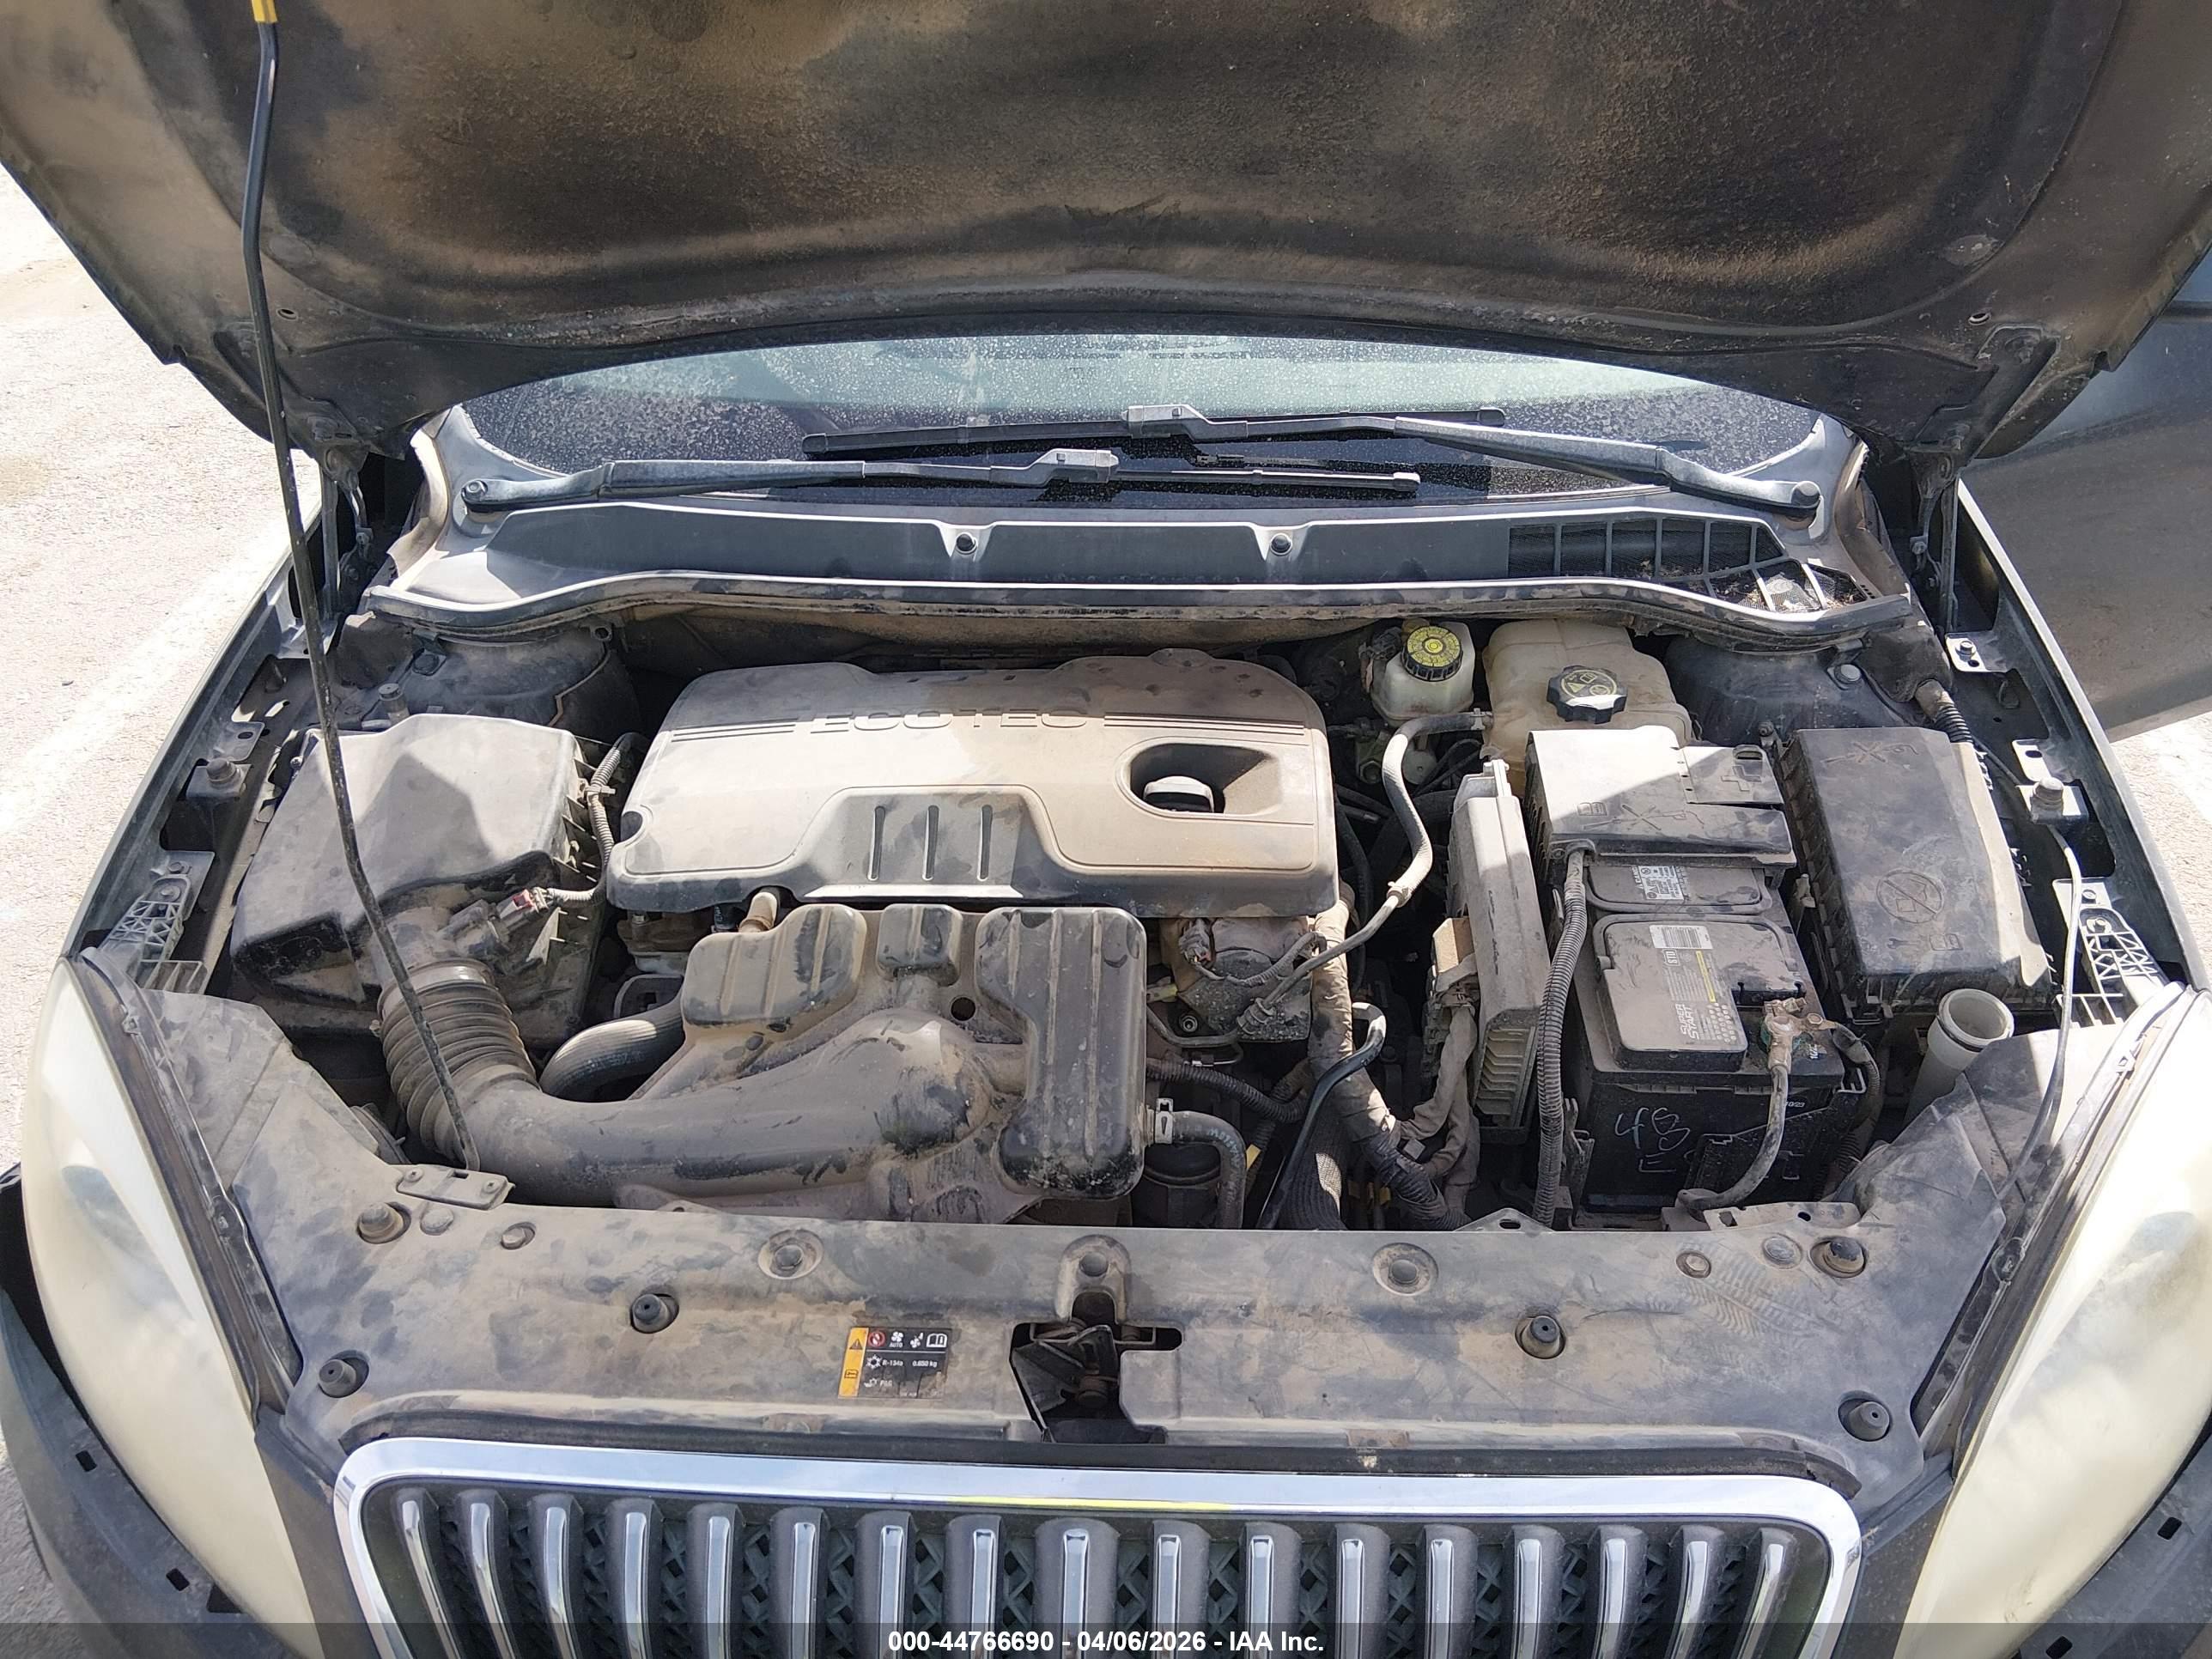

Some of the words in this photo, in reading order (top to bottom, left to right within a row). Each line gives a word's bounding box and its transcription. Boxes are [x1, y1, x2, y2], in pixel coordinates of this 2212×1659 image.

[810, 707, 1088, 734] ECOTEC
[1674, 1003, 1687, 1035] SUPER
[1683, 1005, 1699, 1040] START
